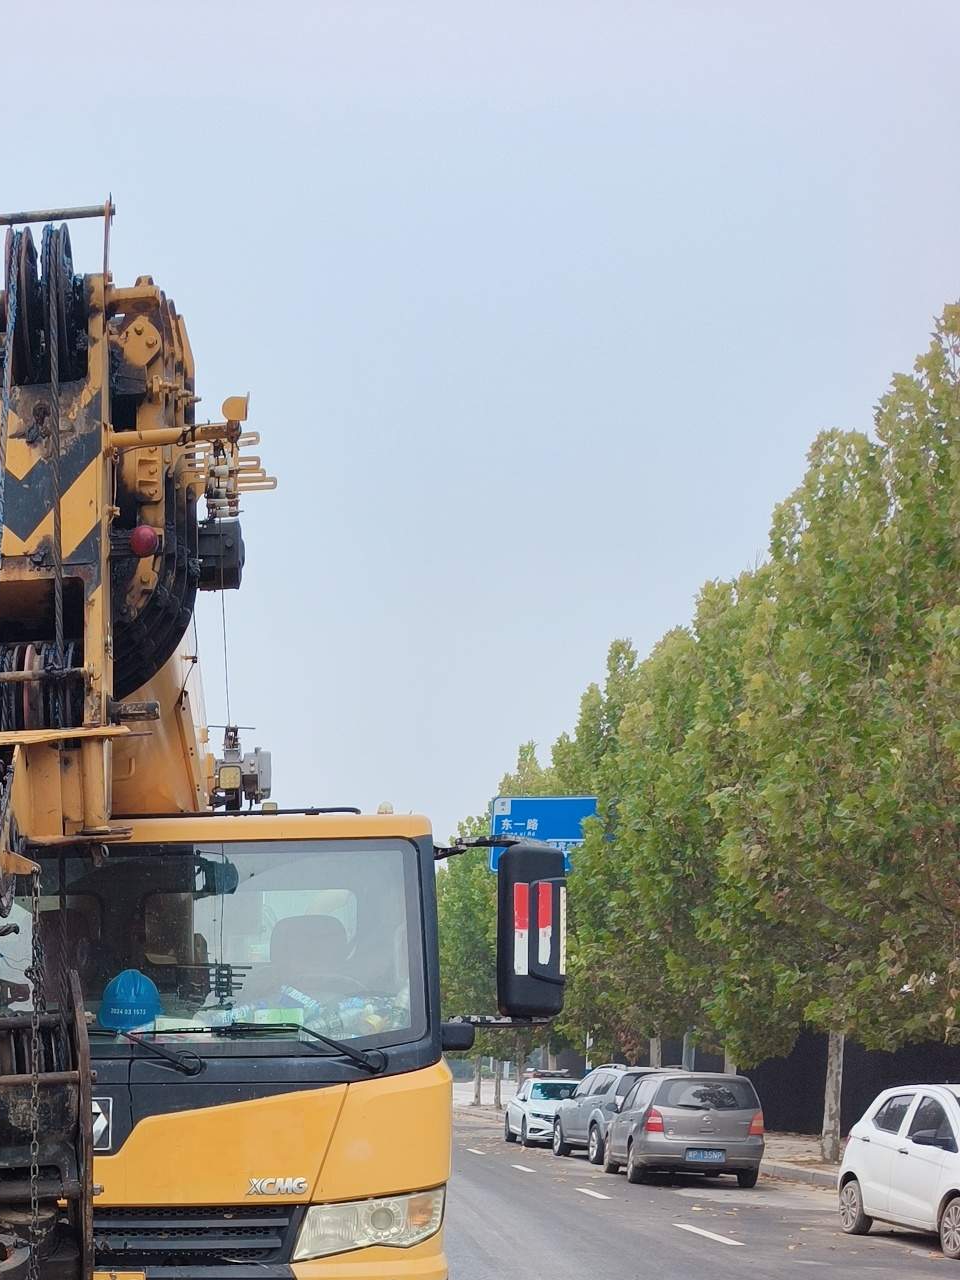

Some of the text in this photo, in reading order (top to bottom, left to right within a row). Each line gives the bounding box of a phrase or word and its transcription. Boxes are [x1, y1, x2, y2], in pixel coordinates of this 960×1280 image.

[501, 818, 538, 831] 东一路
[248, 1177, 308, 1195] XCMG
